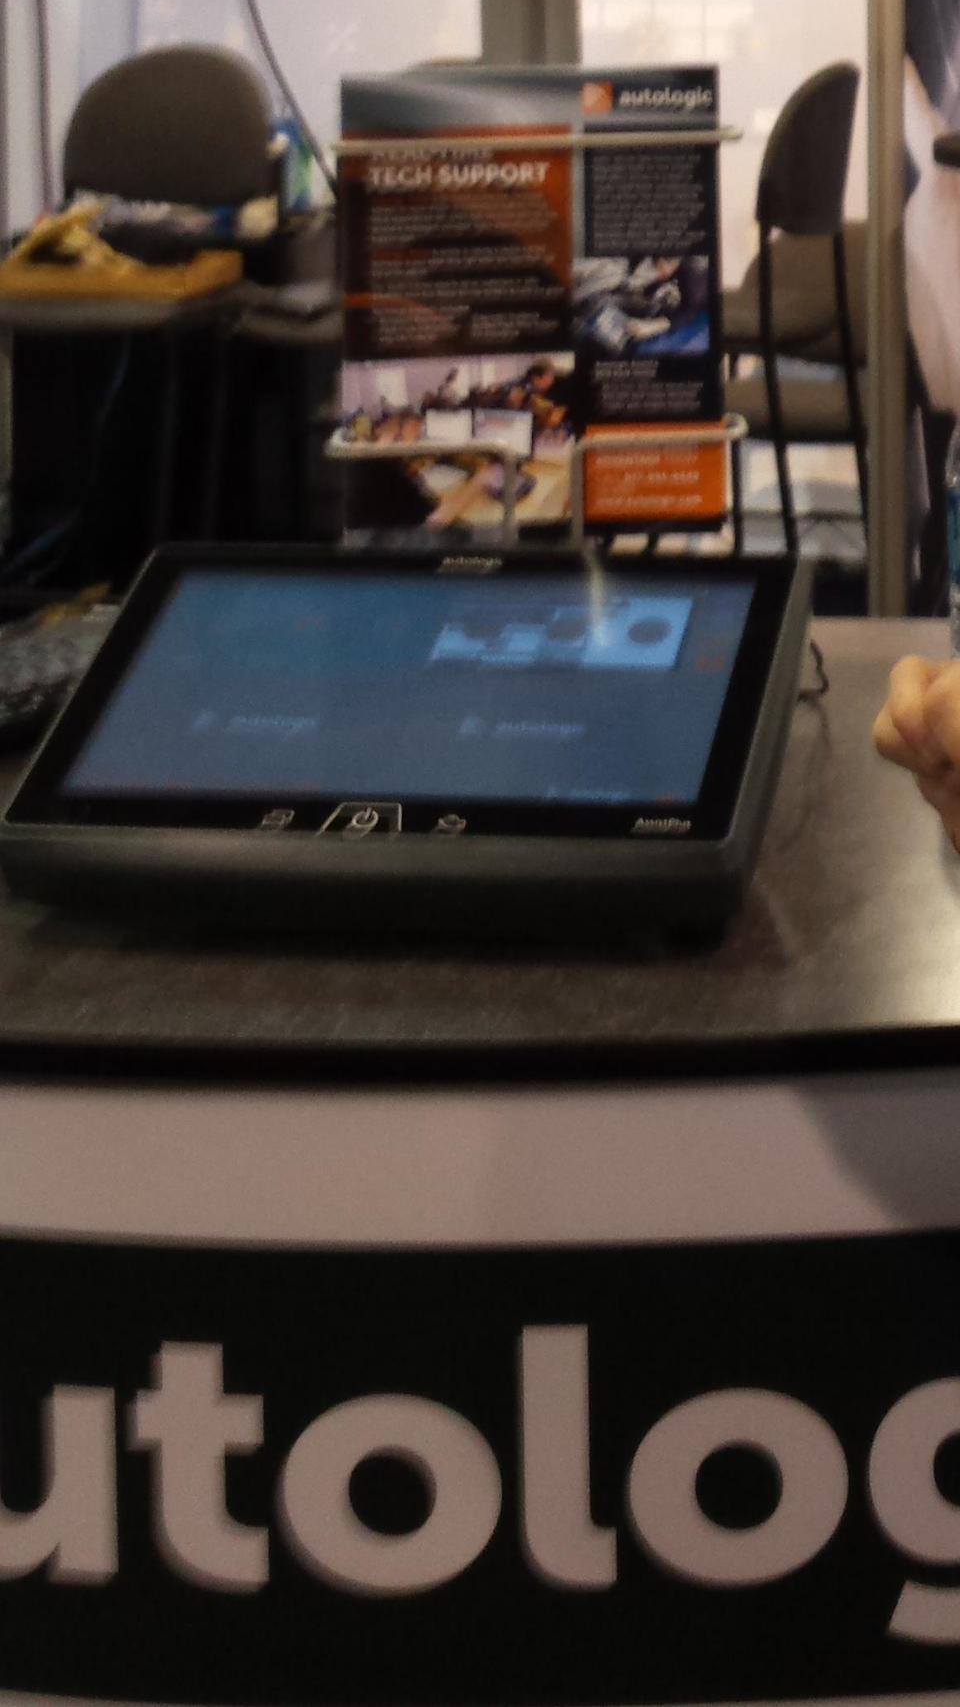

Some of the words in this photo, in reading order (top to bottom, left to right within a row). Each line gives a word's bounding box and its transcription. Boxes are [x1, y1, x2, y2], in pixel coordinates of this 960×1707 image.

[618, 85, 713, 109] autologic
[370, 164, 433, 188] TECH
[438, 160, 549, 188] SUPPORT
